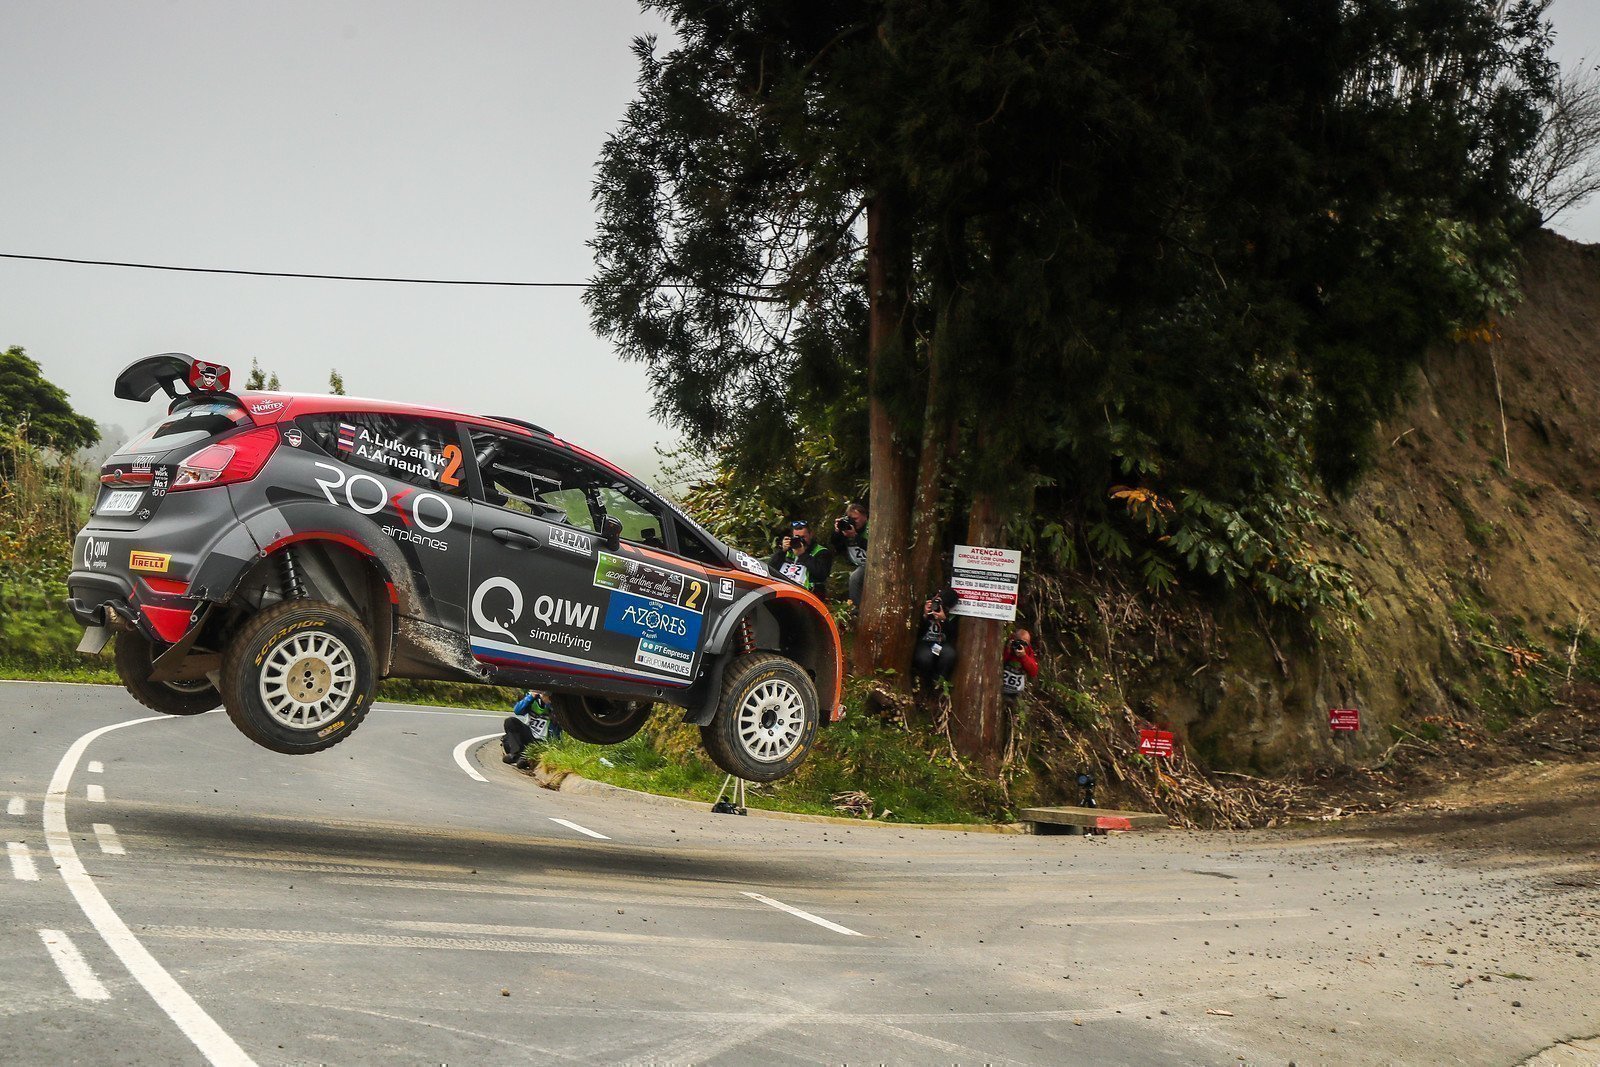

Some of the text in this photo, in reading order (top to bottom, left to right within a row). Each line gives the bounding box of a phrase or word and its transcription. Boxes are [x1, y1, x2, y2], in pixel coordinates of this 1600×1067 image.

[252, 402, 284, 412] HORTEX
[358, 429, 446, 467] A.Lukyanuk
[356, 444, 440, 480] A.Arnautov
[440, 444, 462, 487] 2
[94, 541, 110, 558] QIWI
[381, 525, 448, 552] airplanes
[549, 526, 591, 551] RPM
[131, 554, 165, 568] PIRELLI
[783, 565, 801, 576] 32
[685, 581, 701, 609] 2
[533, 595, 600, 630] QIWI
[621, 605, 687, 636] AZORES
[254, 619, 325, 667] SCORPION
[529, 627, 592, 651] simplifying
[653, 644, 690, 660] PT Empresas
